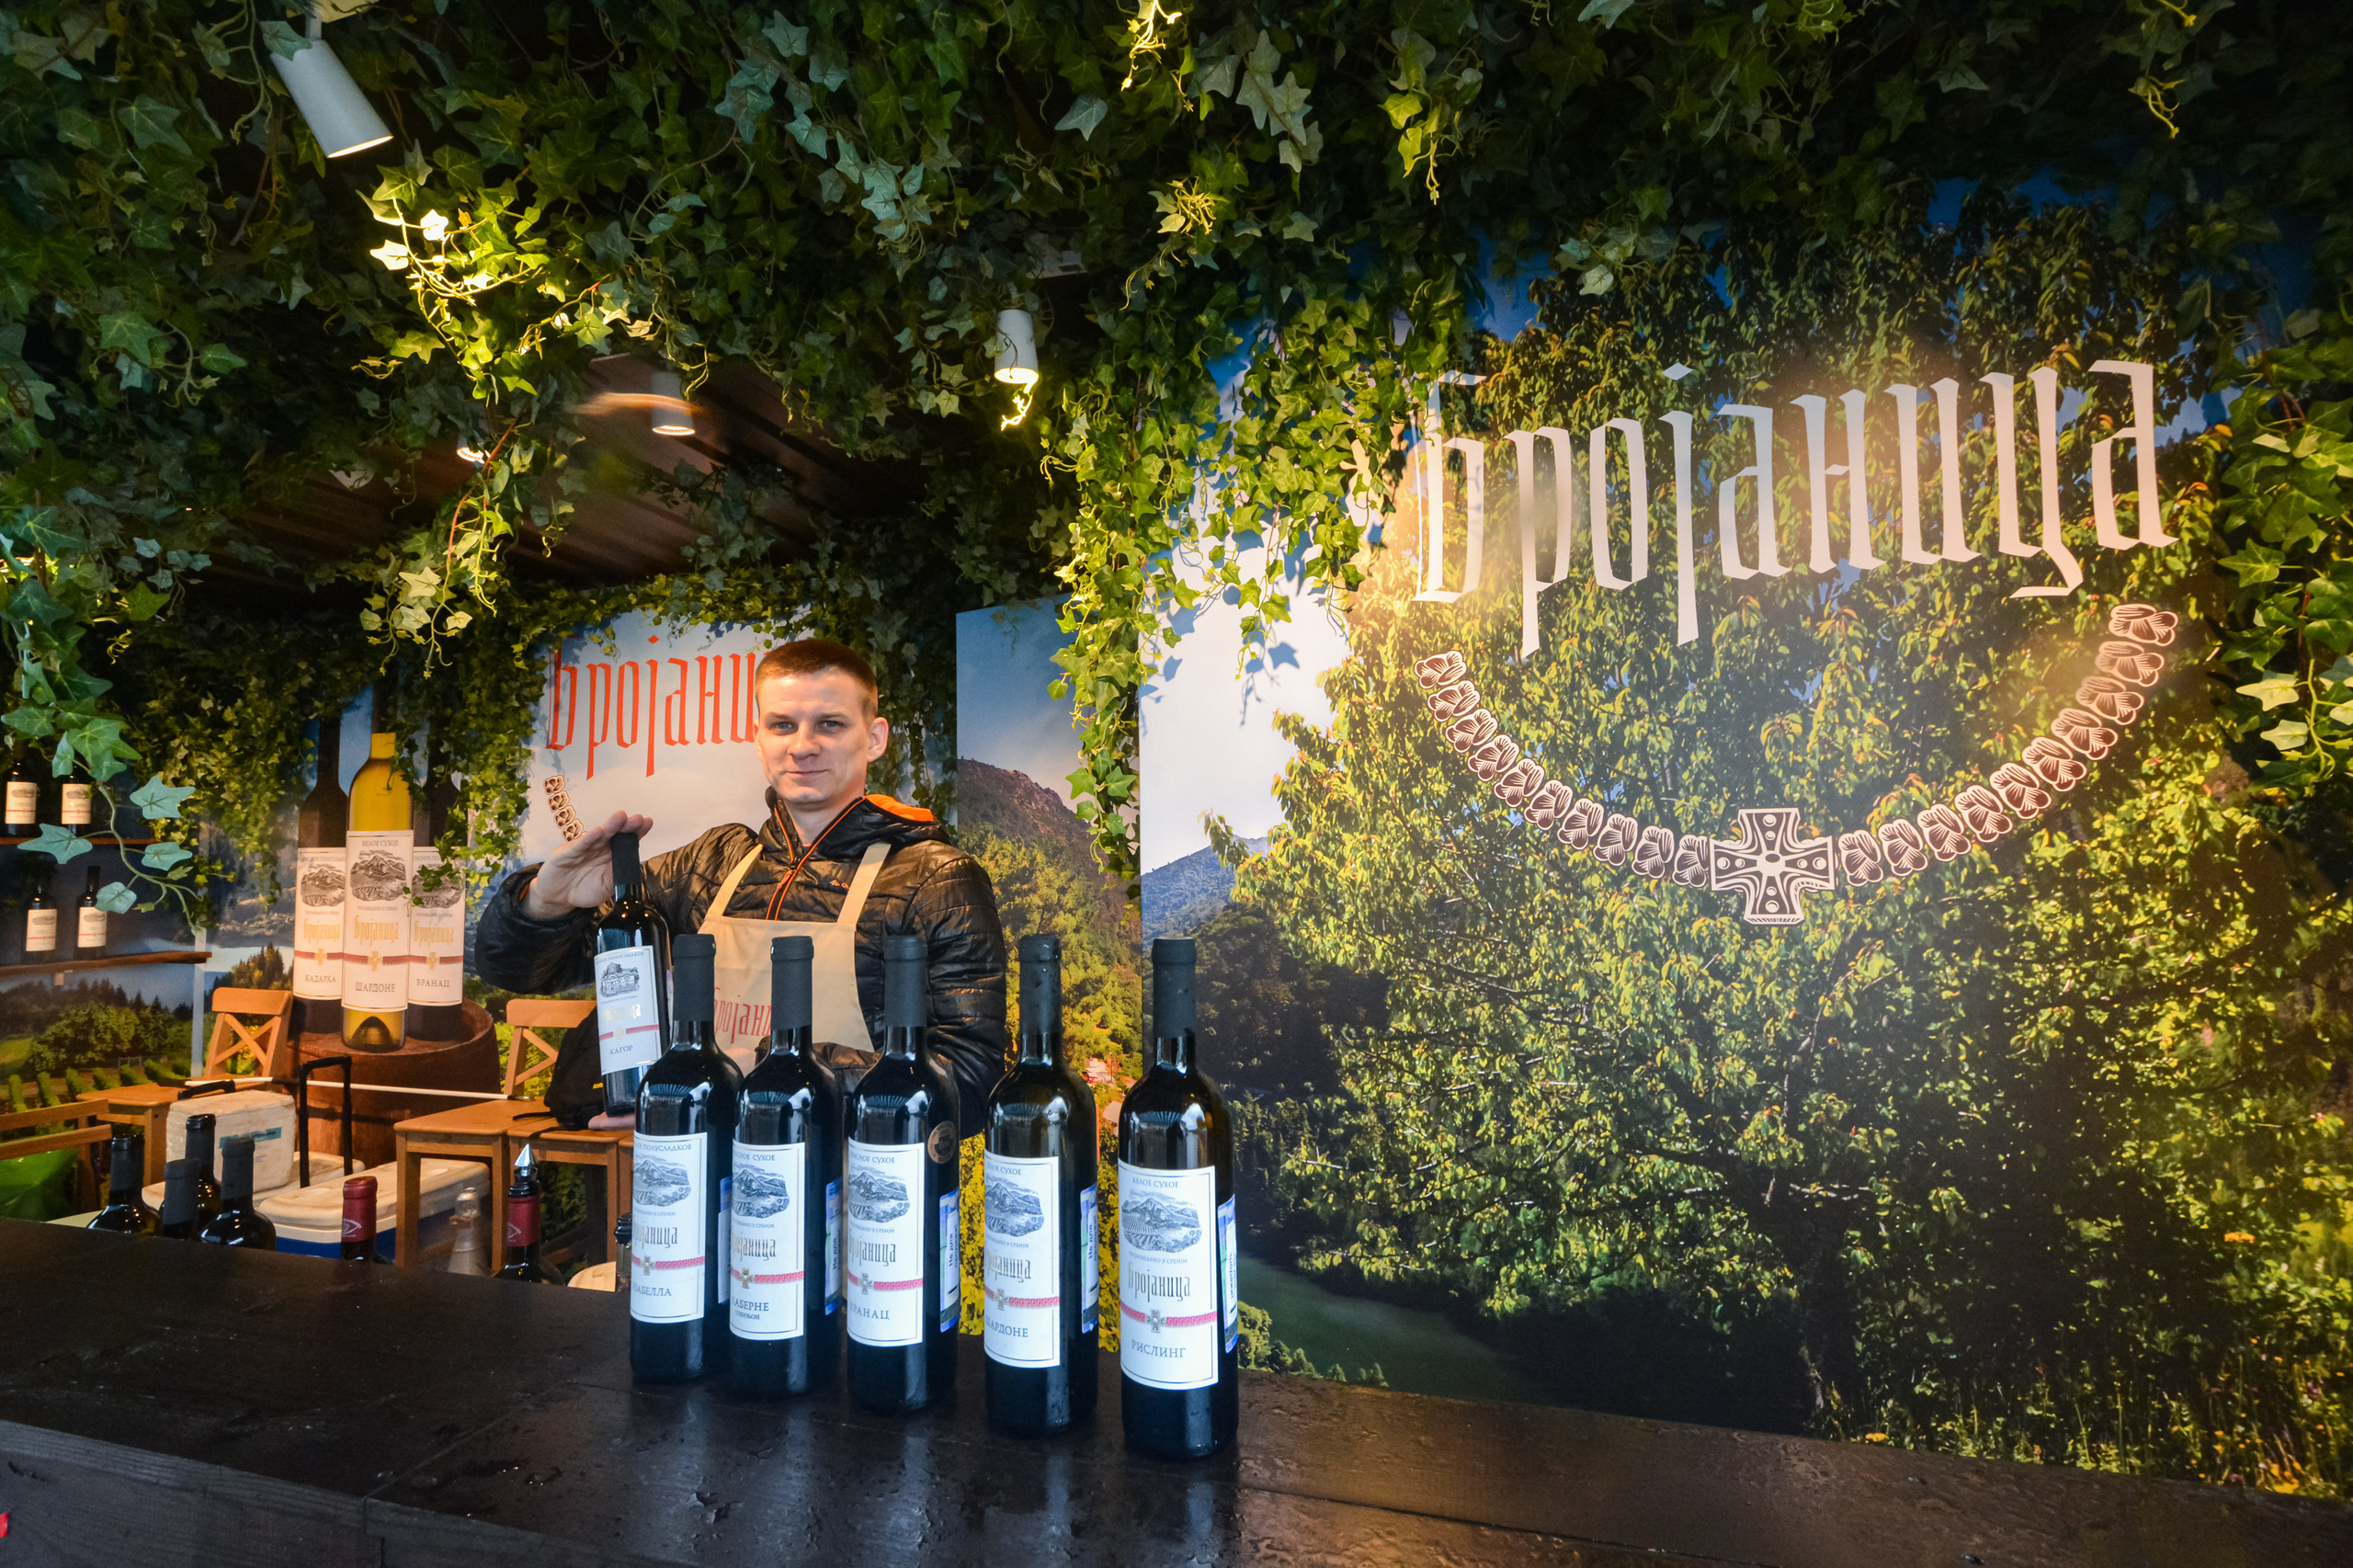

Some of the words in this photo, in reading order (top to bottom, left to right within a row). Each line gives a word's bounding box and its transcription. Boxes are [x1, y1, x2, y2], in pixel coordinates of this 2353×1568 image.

[545, 632, 765, 781] Бројани
[304, 974, 336, 983] КАДАРКА
[416, 978, 450, 988] ВРАНАЦ
[355, 981, 396, 993] ШАРДОНЕ
[609, 1044, 633, 1056] КАГОР
[872, 1156, 895, 1165] СУХОЕ
[1000, 1166, 1022, 1176] СУХОЕ
[1132, 1176, 1152, 1187] БЕЛОЕ
[1154, 1180, 1179, 1188] СУХОЕ
[1131, 1339, 1187, 1359] РИСЛИНГ
